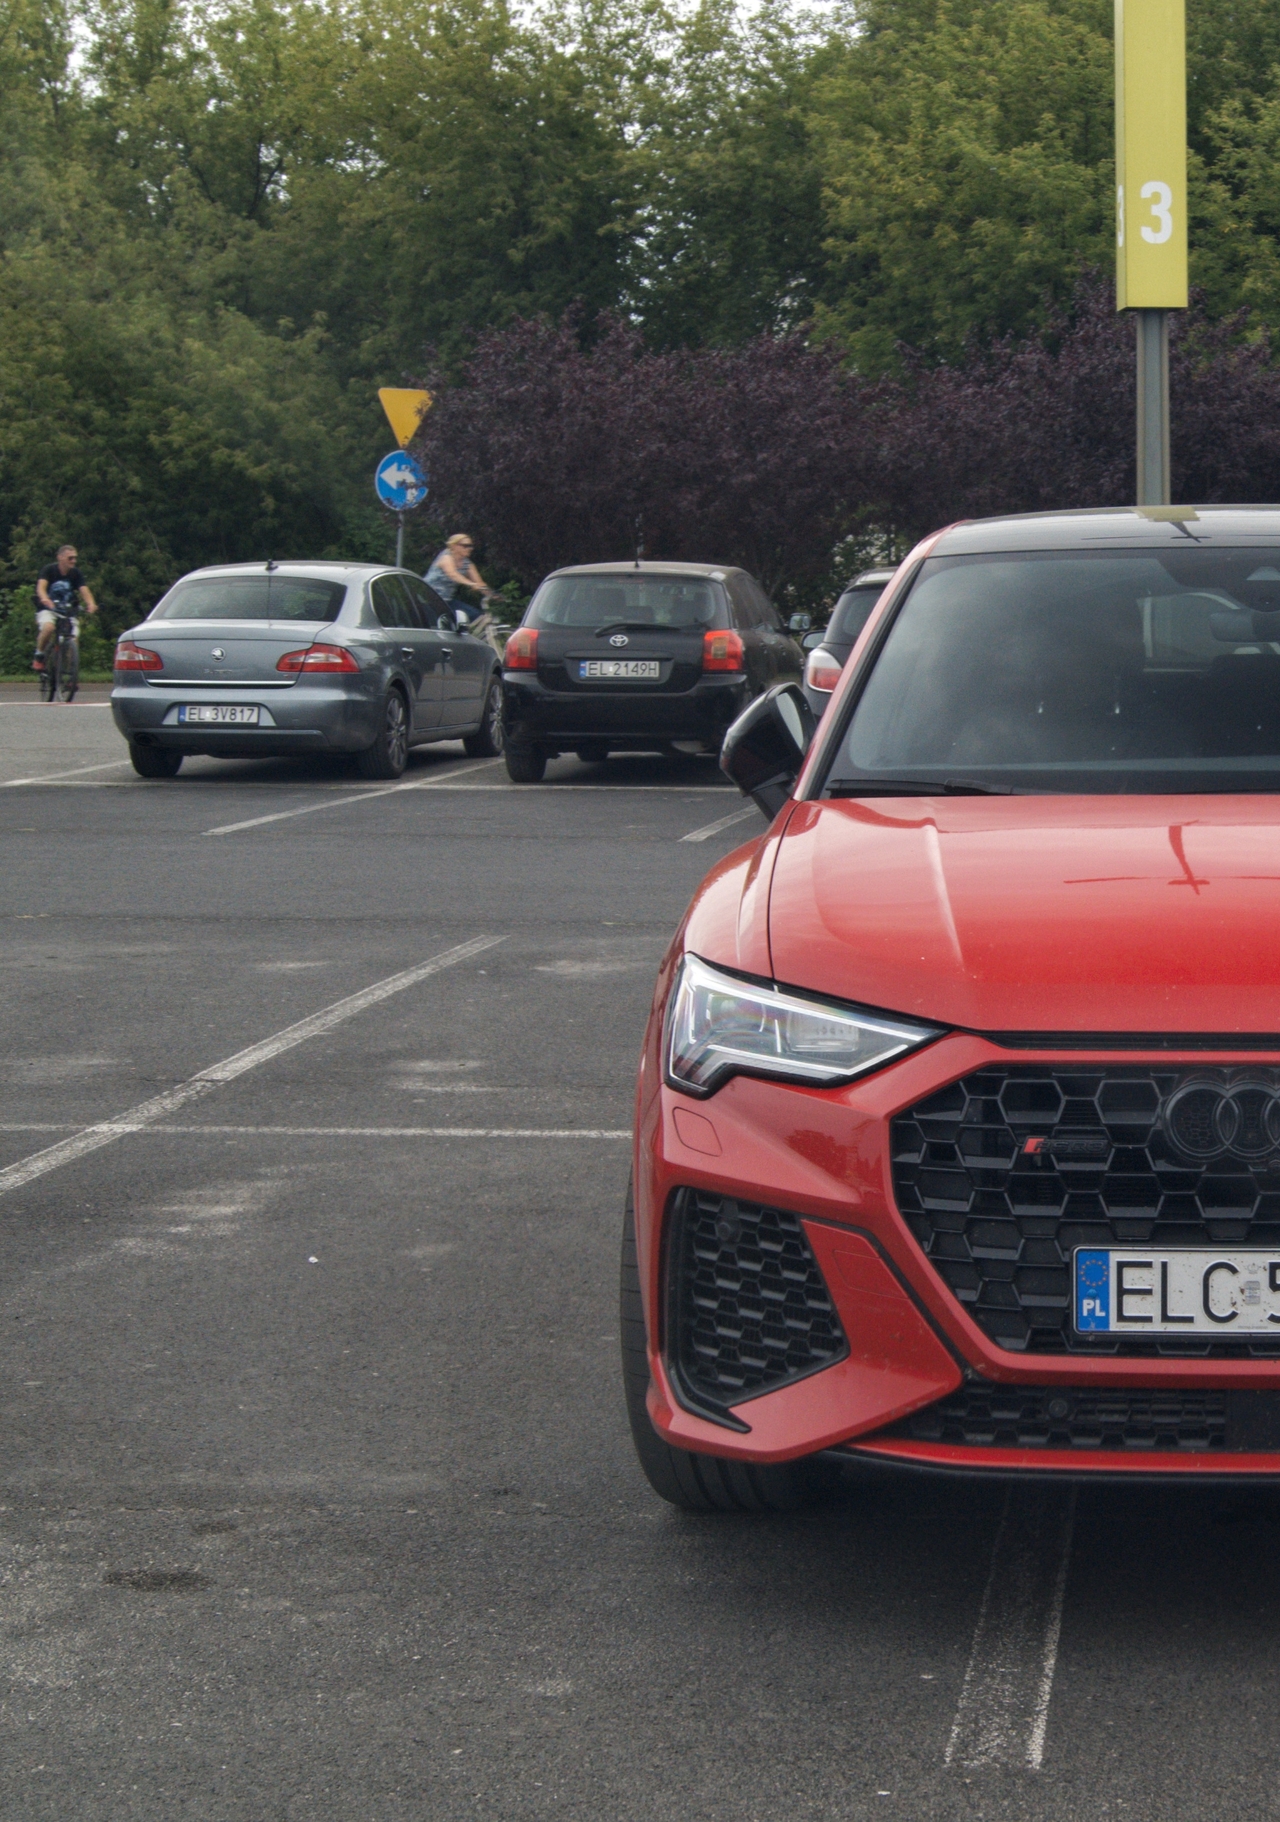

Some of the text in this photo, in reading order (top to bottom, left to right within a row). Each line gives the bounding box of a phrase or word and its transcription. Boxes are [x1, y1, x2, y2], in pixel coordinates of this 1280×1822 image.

[1140, 180, 1173, 244] 3
[588, 662, 607, 676] EL
[613, 662, 657, 676] 2149H
[188, 707, 206, 721] EL
[211, 707, 255, 722] 3V817
[1116, 1260, 1240, 1324] ELC
[1082, 1299, 1106, 1317] PL
